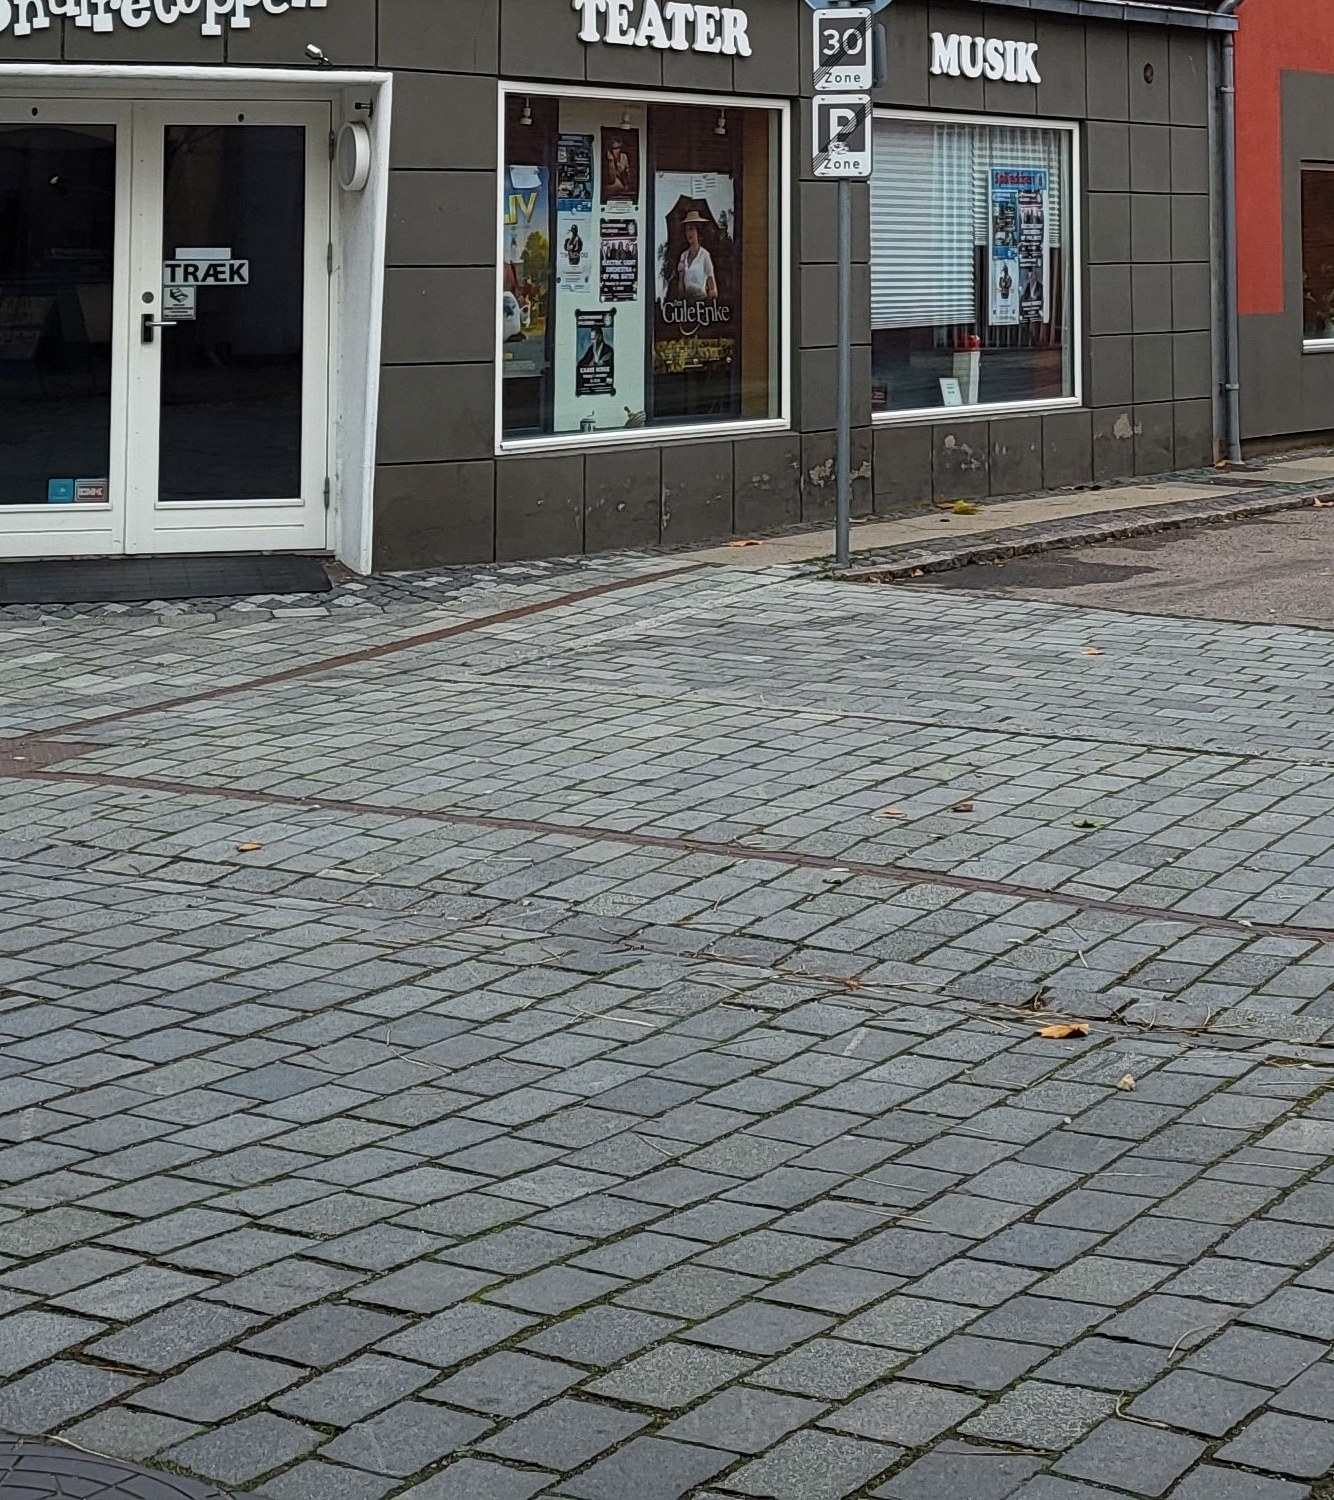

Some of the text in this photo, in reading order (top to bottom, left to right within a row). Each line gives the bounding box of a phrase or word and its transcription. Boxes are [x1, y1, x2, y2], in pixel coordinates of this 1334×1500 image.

[823, 27, 863, 56] 30
[929, 31, 1043, 85] MUSIK
[824, 71, 861, 84] Zone
[823, 157, 860, 171] Zone
[164, 262, 247, 283] TRÆK
